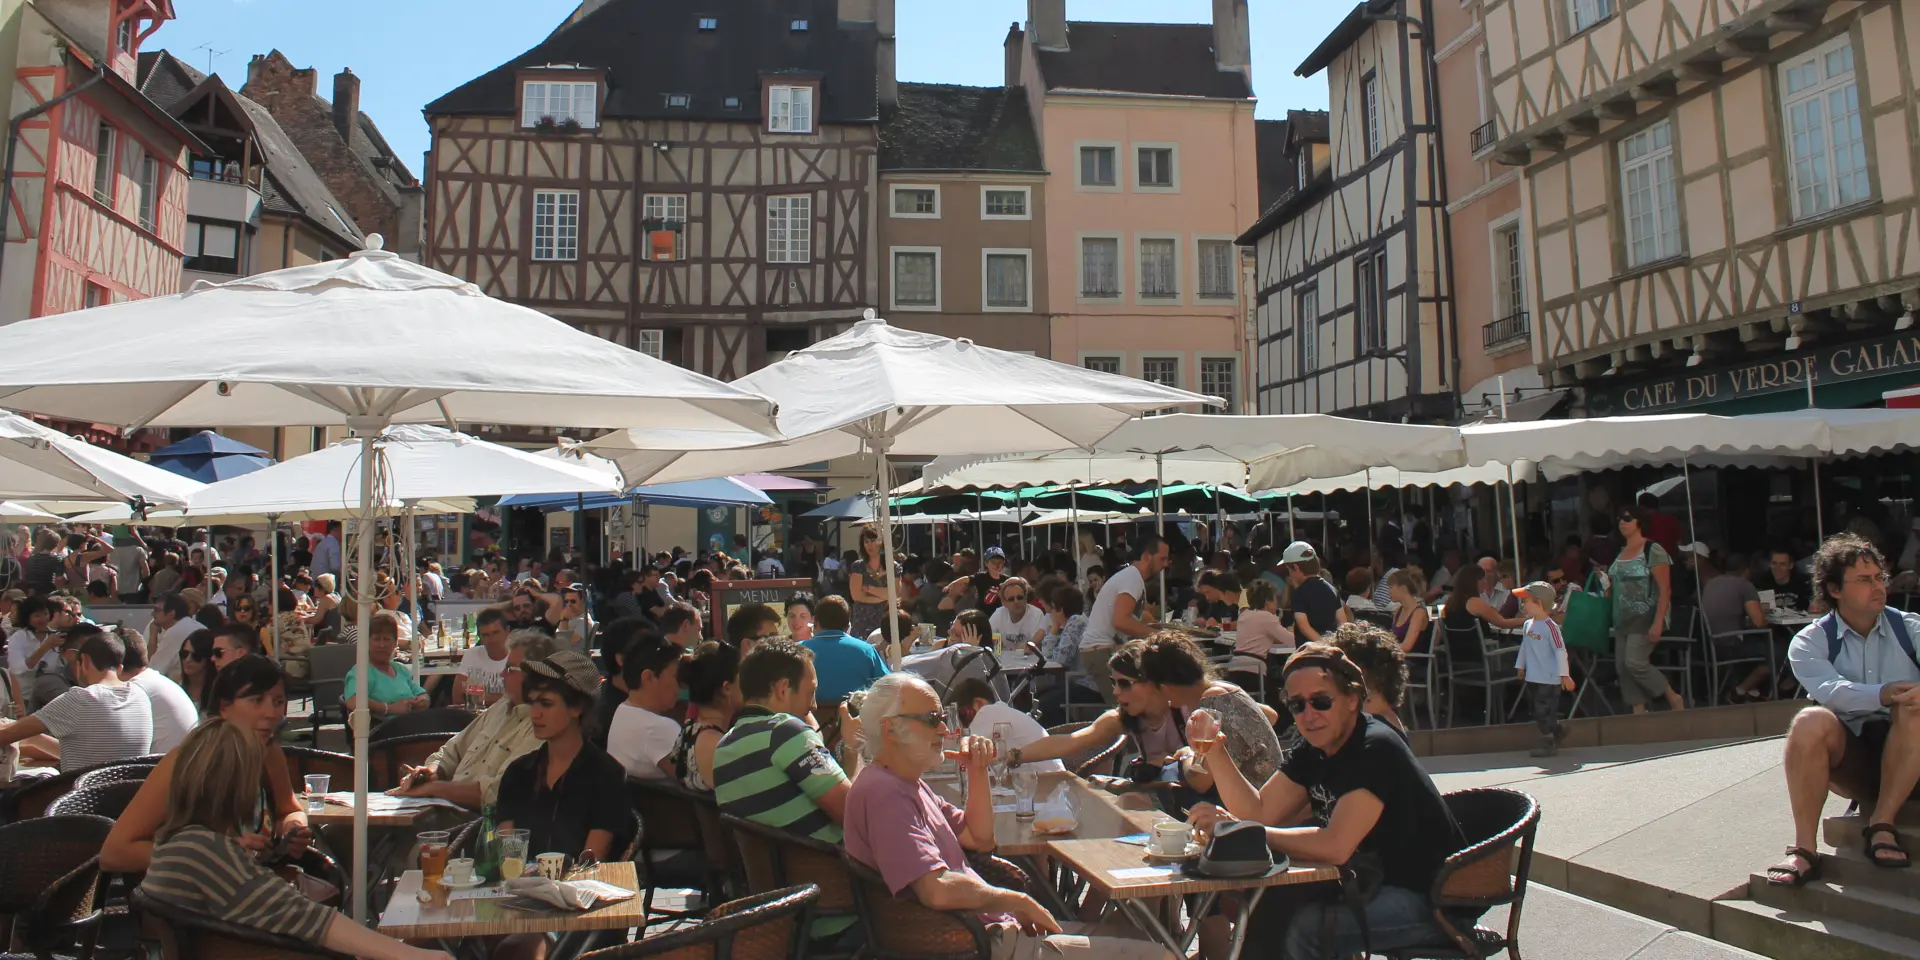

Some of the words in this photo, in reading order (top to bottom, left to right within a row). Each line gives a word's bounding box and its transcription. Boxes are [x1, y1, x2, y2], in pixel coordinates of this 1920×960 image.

[1791, 302, 1799, 312] 8
[1624, 380, 1676, 410] CAFE
[1687, 374, 1717, 401] DU
[1728, 355, 1818, 393] VERRE
[740, 590, 779, 603] MENU
